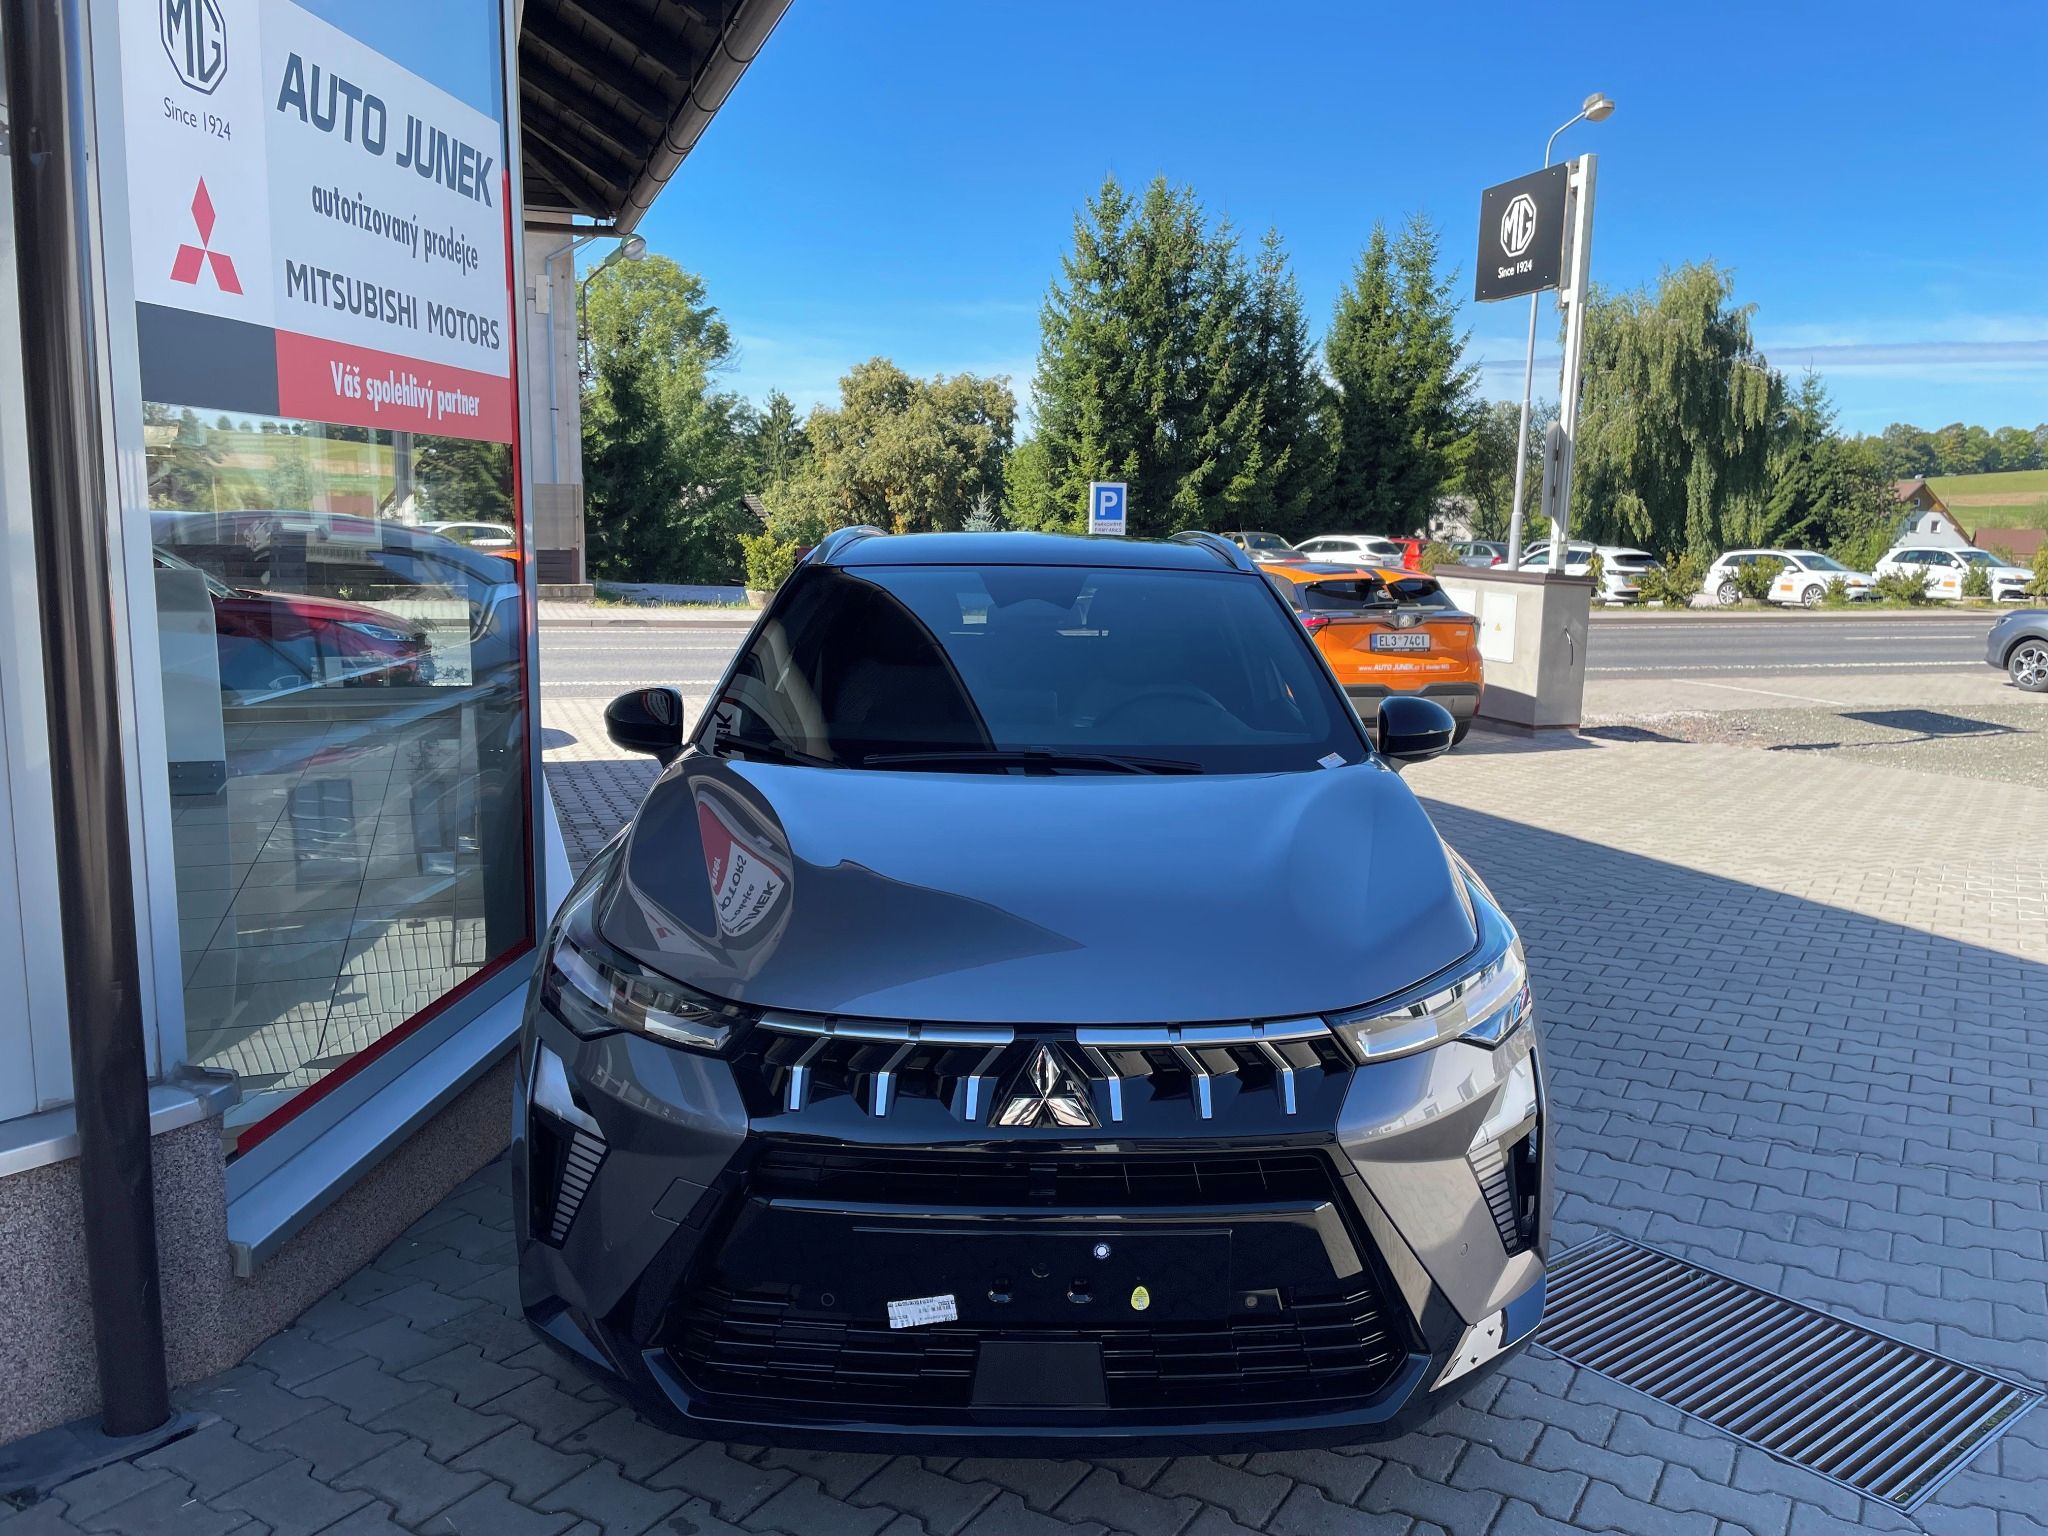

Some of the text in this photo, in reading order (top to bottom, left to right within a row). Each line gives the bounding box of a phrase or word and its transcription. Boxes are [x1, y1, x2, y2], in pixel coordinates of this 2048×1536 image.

[163, 0, 225, 88] MG
[163, 97, 232, 141] Since 1924
[276, 52, 494, 208] AUTO JUNEK
[311, 184, 479, 276] autorizovaný prodejce
[1502, 197, 1535, 254] MG
[1498, 259, 1533, 279] Since 1924
[285, 259, 500, 350] MITSUBISHI MOTORS
[330, 361, 480, 420] Váš spolehlivý partner
[1100, 491, 1118, 516] P
[1379, 636, 1397, 647] EL3
